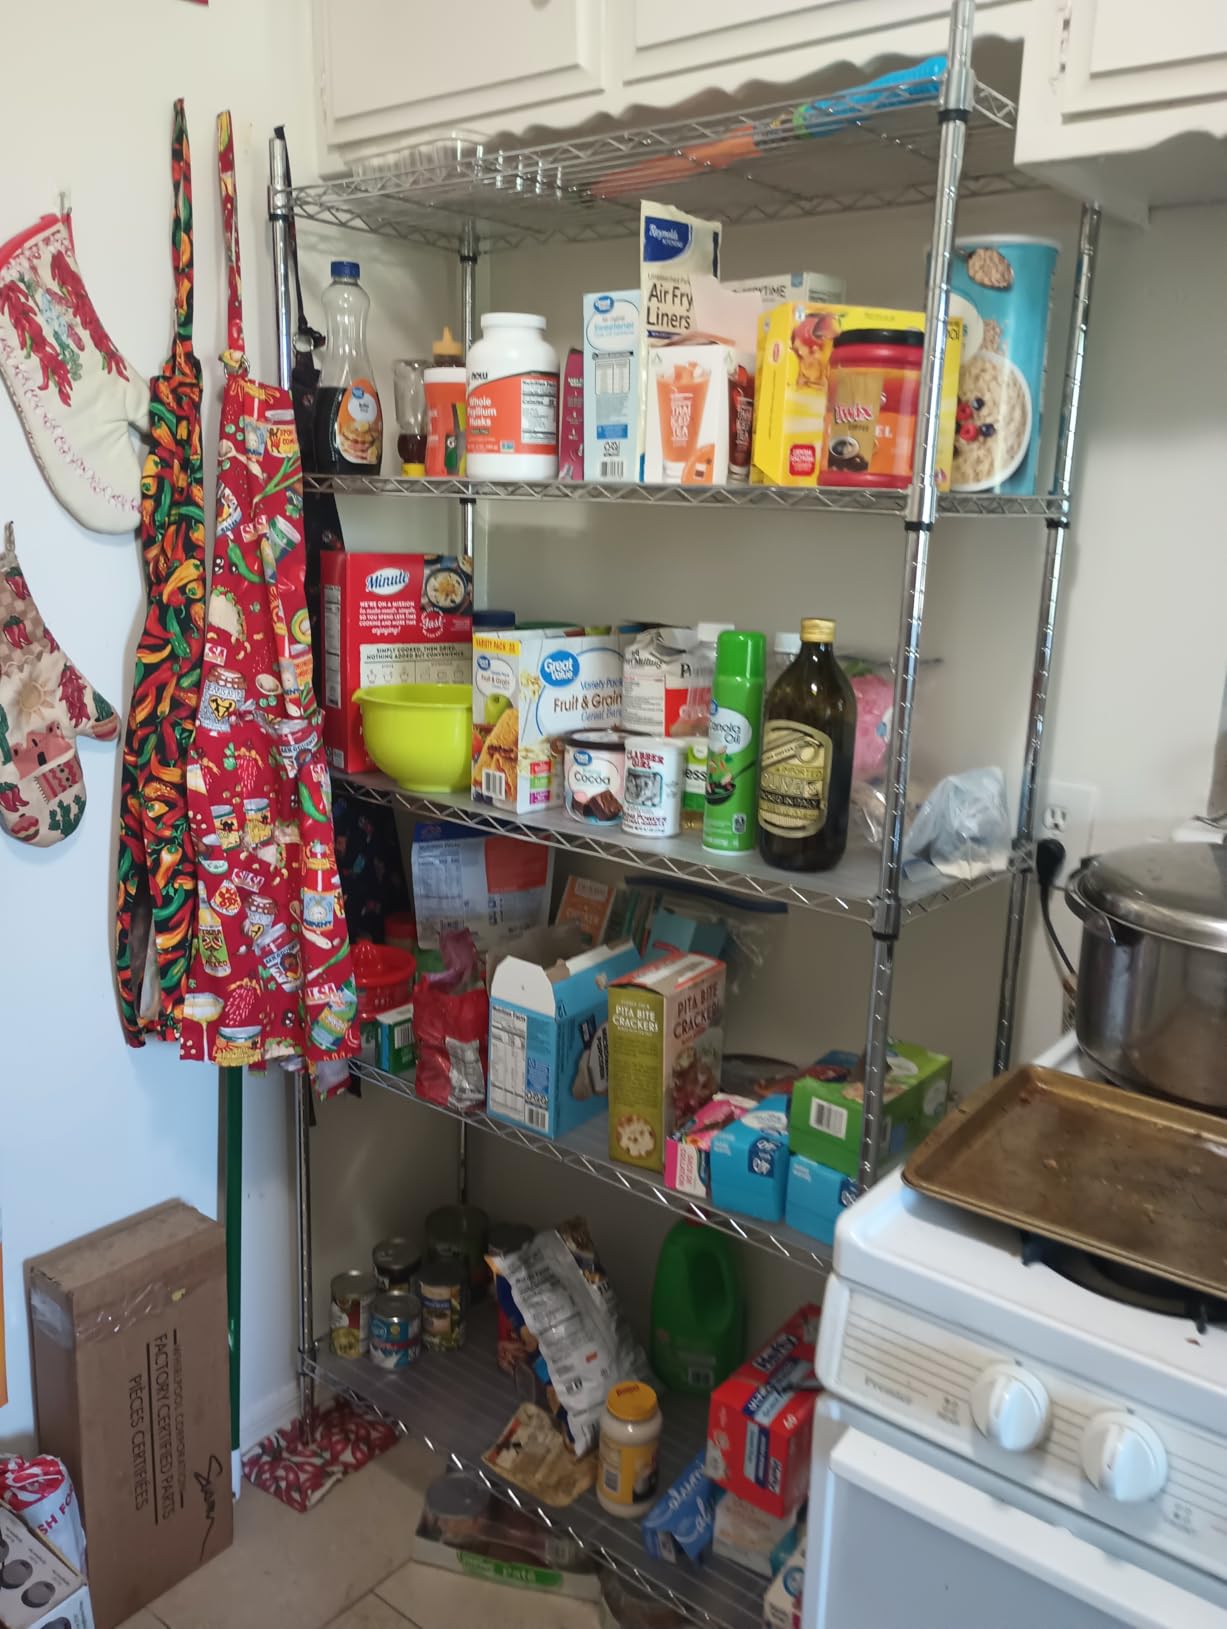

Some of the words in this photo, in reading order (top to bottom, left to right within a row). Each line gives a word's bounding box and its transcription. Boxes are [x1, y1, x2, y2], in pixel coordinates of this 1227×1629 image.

[648, 224, 679, 241] Reynolds
[648, 282, 669, 304] Air
[672, 286, 693, 312] Fry
[647, 306, 691, 330] Liners
[366, 569, 410, 592] Minute
[543, 658, 574, 674] Great
[550, 669, 575, 682] Value
[553, 693, 580, 713] Fruit
[581, 696, 589, 709] &
[591, 691, 623, 708] Grain
[711, 721, 741, 734] anola
[724, 733, 741, 745] Oil
[574, 770, 611, 785] Cocoa
[677, 994, 699, 1018] PITA
[700, 981, 719, 1005] BITE
[612, 1015, 659, 1033] CRACKERS
[616, 1004, 635, 1018] PITA
[636, 1007, 656, 1022] BITE
[154, 1332, 169, 1401] FACTORY
[129, 1373, 146, 1429] PIÈCES
[157, 1403, 173, 1475] CERTIFIED
[132, 1430, 151, 1512] CERTIFIÉES
[160, 1474, 175, 1521] PARTS
